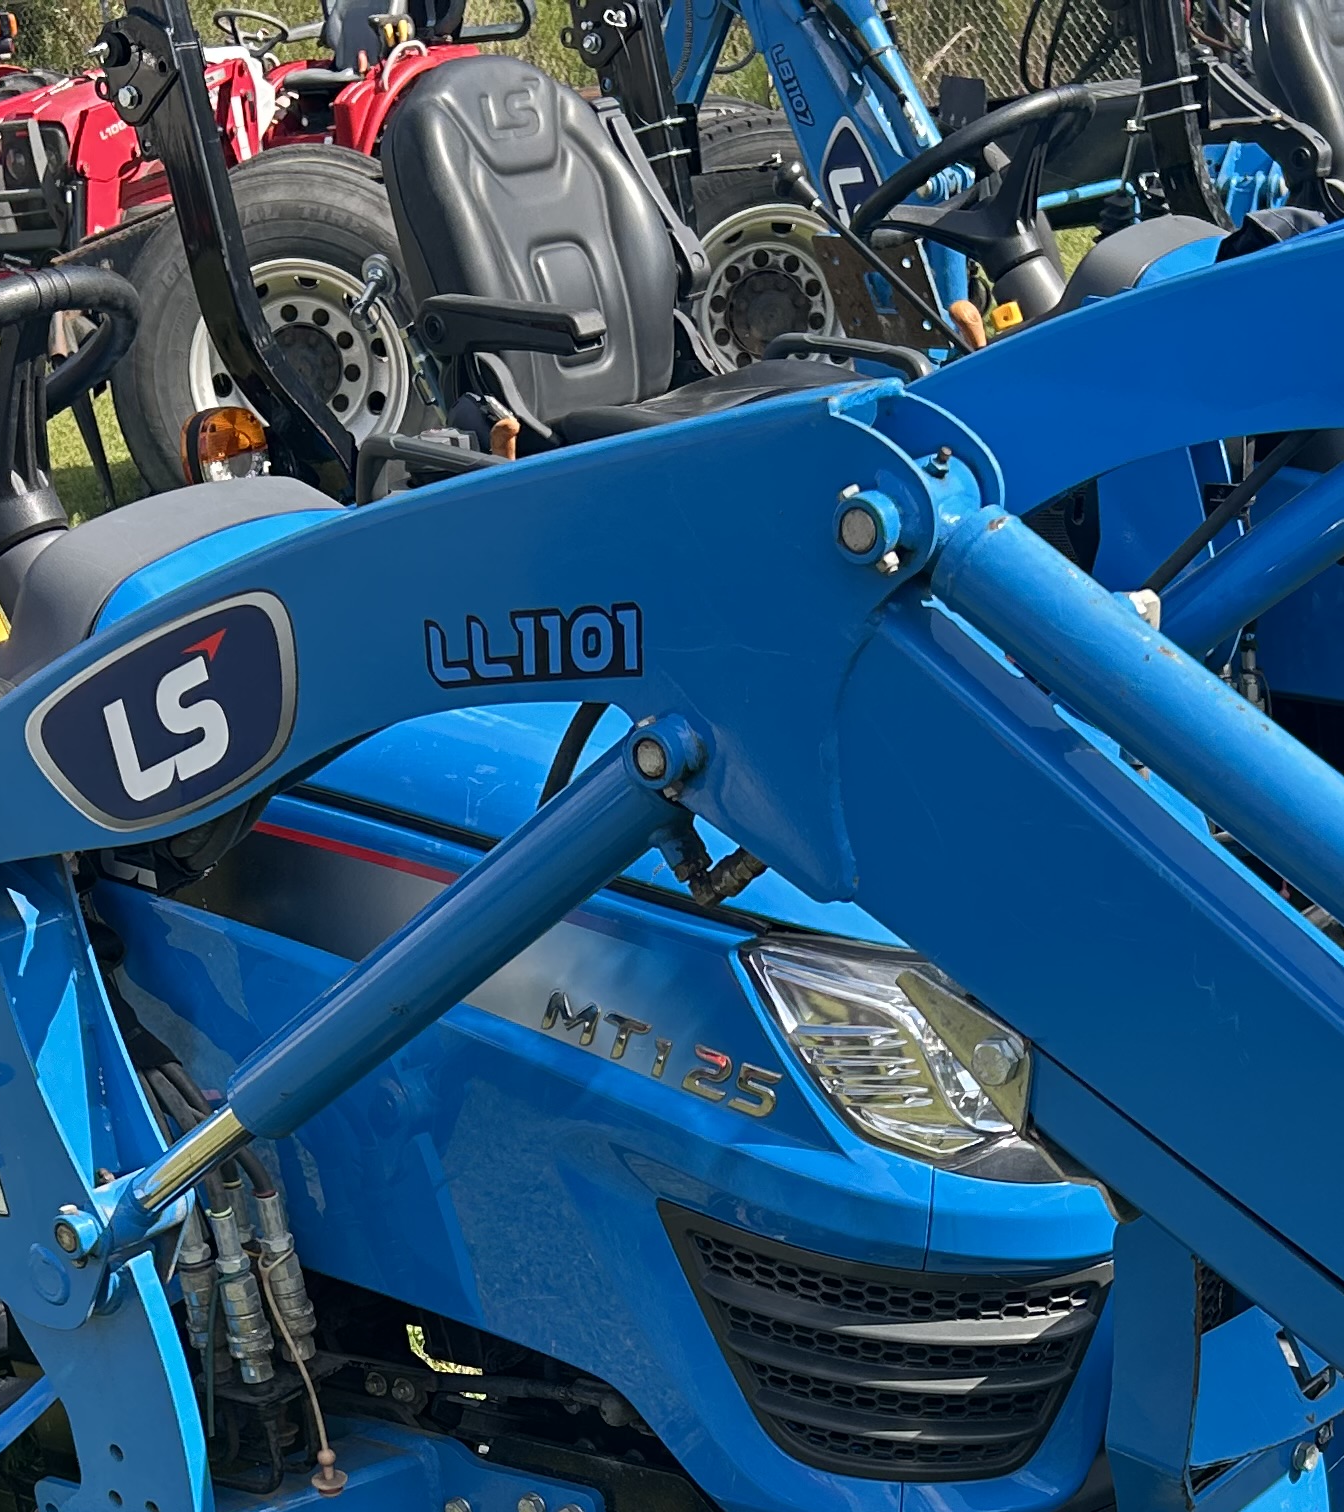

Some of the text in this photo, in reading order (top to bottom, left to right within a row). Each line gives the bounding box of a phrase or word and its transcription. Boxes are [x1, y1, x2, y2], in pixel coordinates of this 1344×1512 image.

[479, 89, 540, 140] LS
[770, 44, 815, 126] LB1107
[423, 602, 643, 689] LL1101
[103, 655, 230, 801] LS
[541, 988, 784, 1118] MT125
